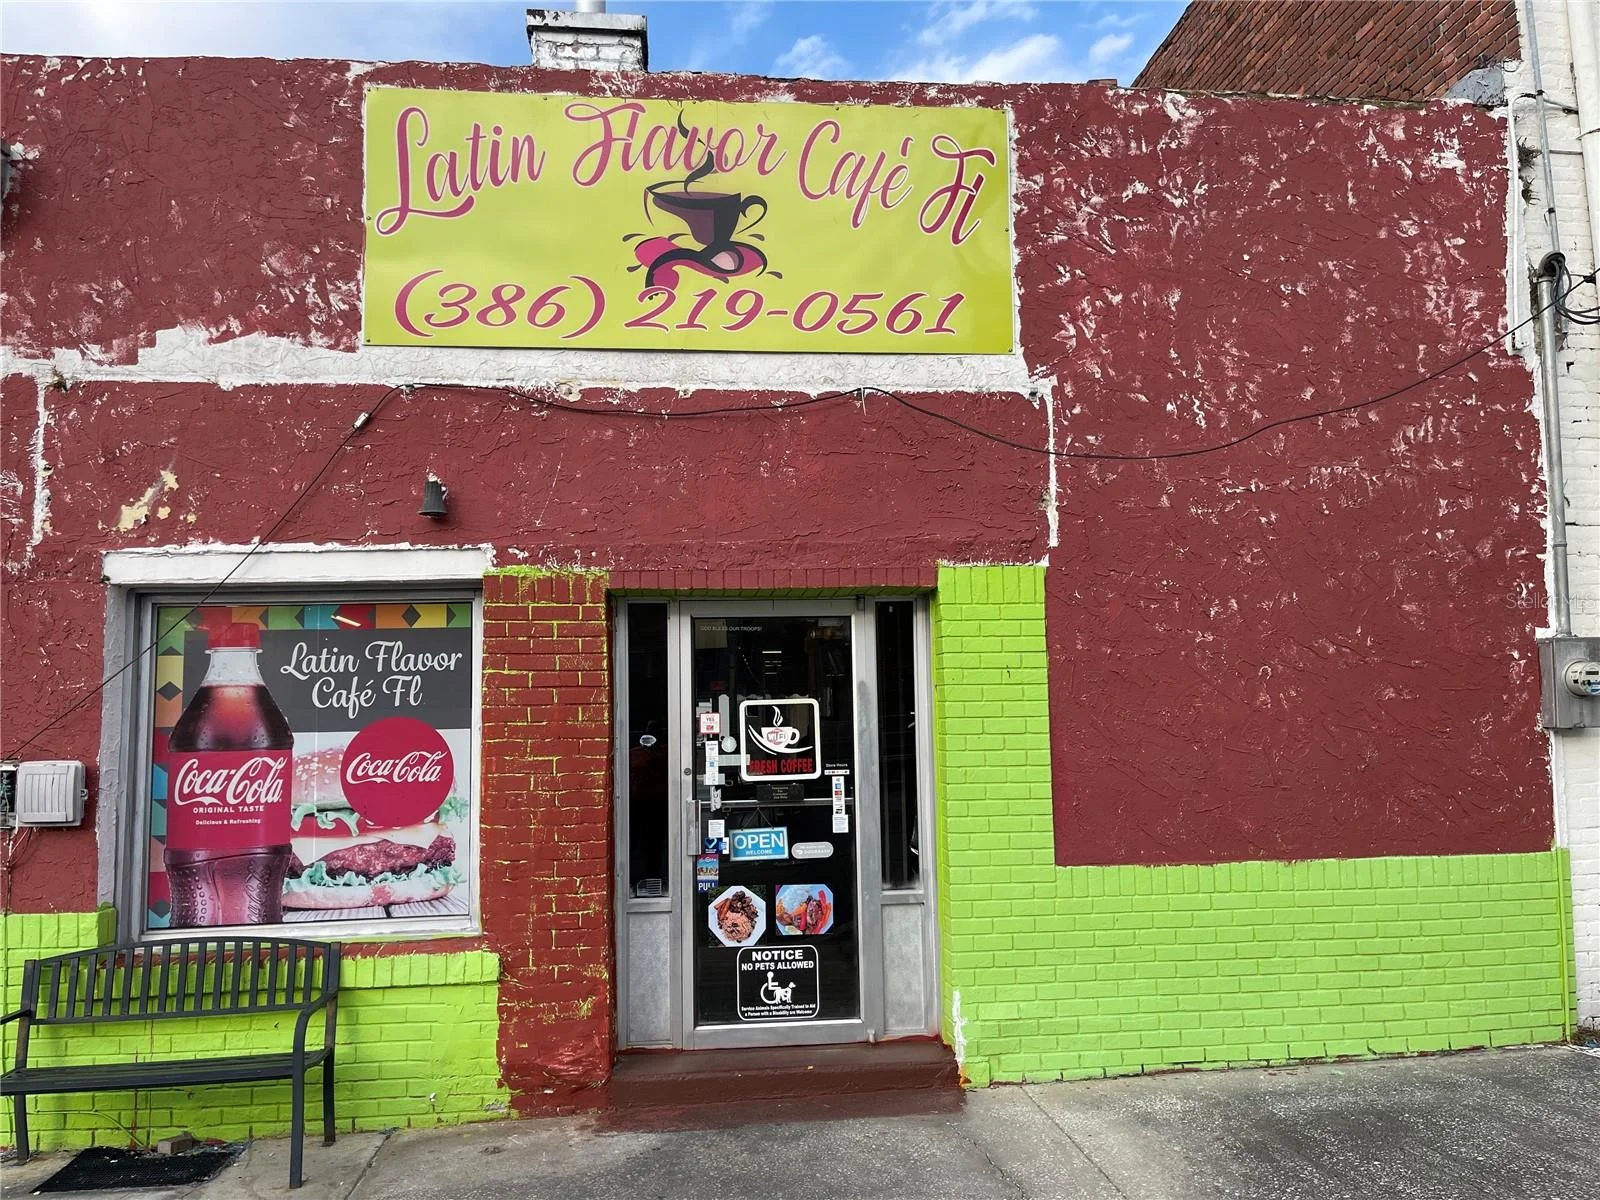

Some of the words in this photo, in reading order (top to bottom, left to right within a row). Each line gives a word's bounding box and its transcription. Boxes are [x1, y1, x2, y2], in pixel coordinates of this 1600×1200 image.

[376, 106, 546, 236] Latin
[564, 102, 787, 187] Flavor
[798, 119, 914, 229] Café
[394, 269, 607, 339] (386)
[623, 287, 967, 336] 219-0561
[280, 641, 360, 681] Latin
[365, 640, 463, 673] Flavor
[311, 676, 377, 720] Café
[382, 674, 423, 707] Fl
[174, 756, 288, 806] Coca-Cola
[346, 750, 448, 784] Coca-Cola
[749, 760, 778, 773] FRESH
[781, 759, 813, 773] COFFEE
[193, 806, 235, 814] ORIGINAL
[238, 805, 265, 813] TASTE
[734, 832, 784, 850] OPEN
[741, 963, 753, 971] NO
[755, 962, 775, 970] PETS
[777, 960, 814, 970] ALLOWED
[751, 949, 804, 962] NOTICE
